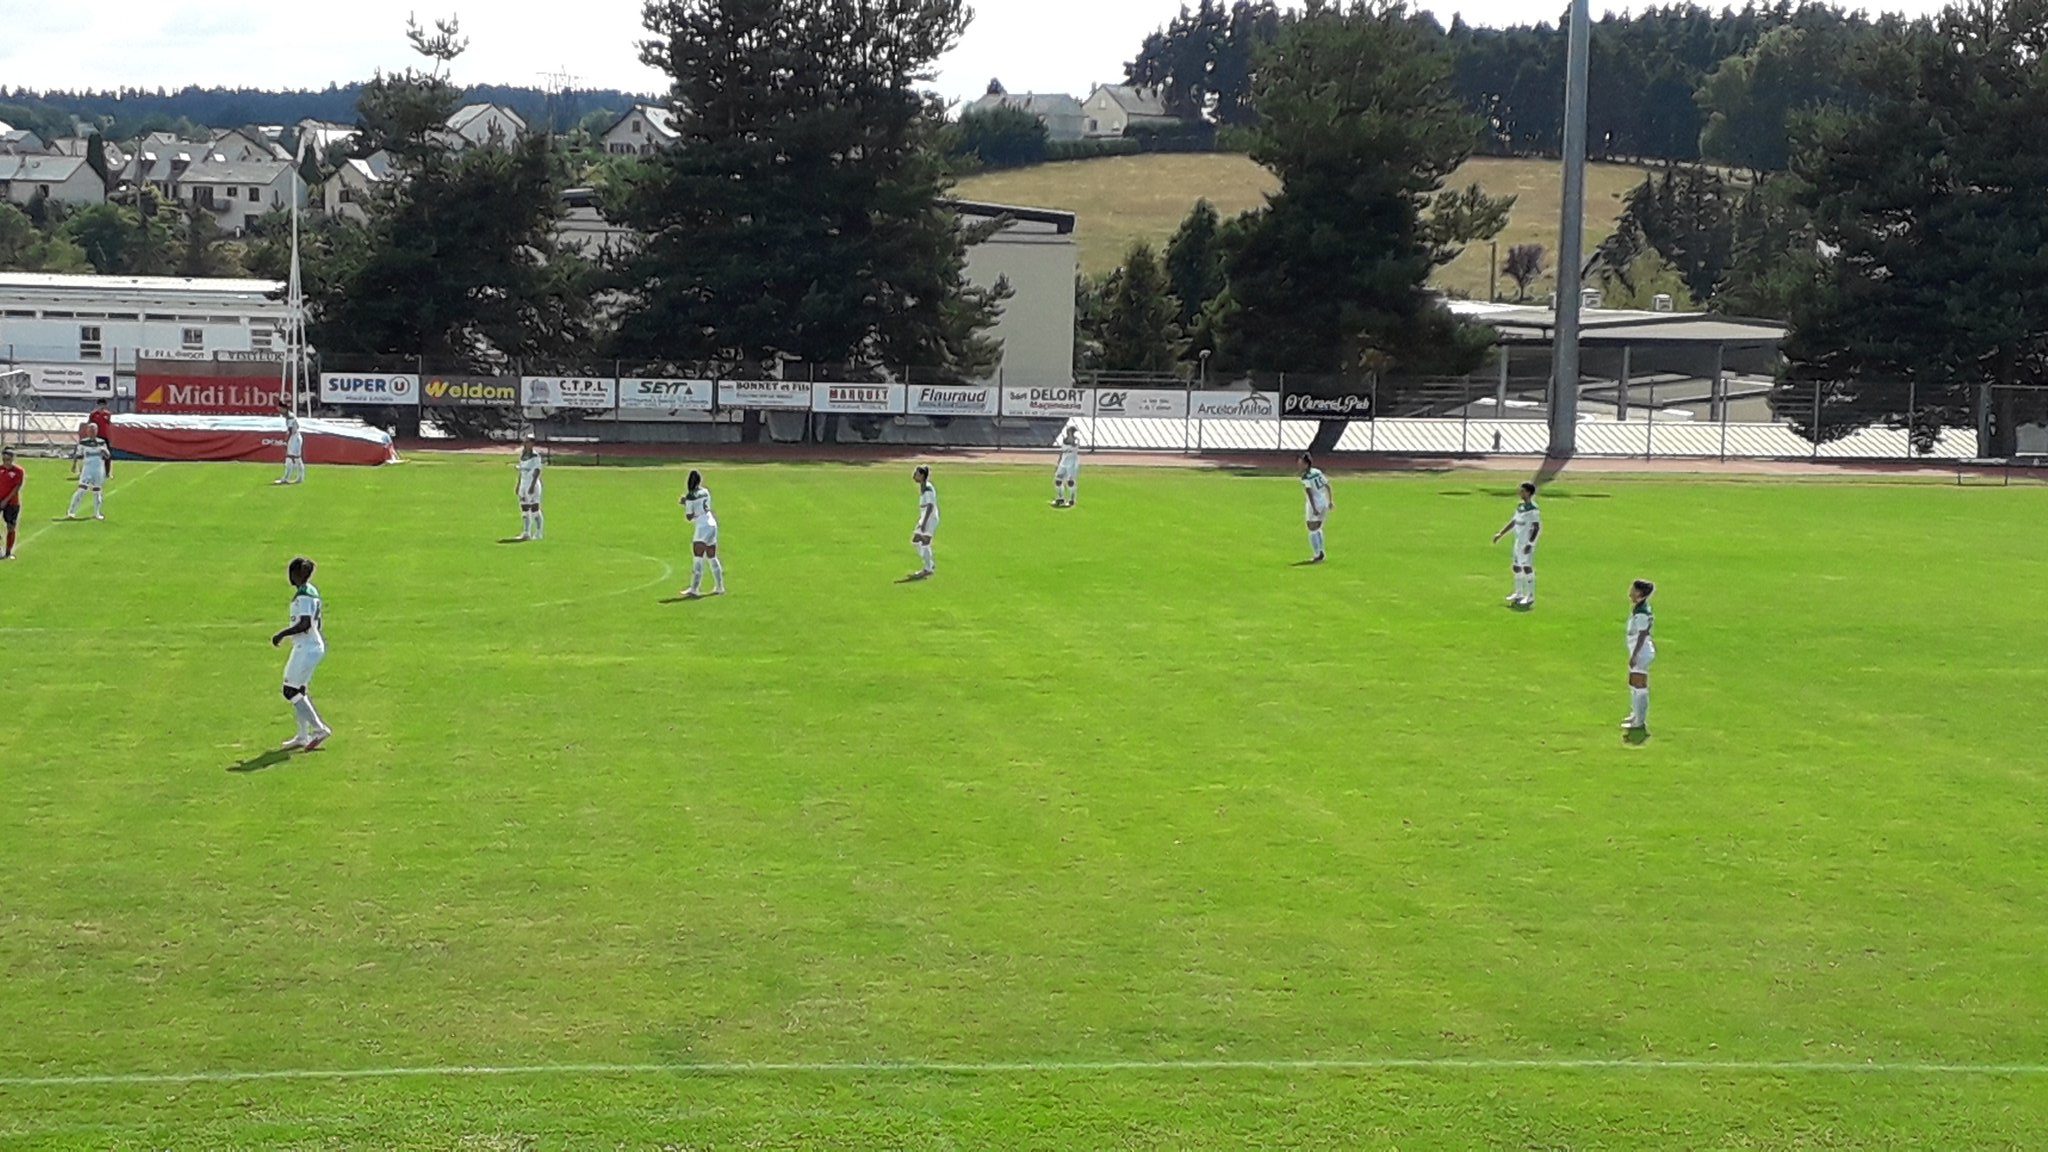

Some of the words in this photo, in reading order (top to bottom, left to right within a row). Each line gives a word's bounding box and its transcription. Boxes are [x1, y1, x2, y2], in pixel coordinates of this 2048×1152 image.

[328, 377, 386, 392] SUPER
[393, 380, 406, 391] U
[425, 380, 515, 398] Weldom
[736, 381, 778, 391] BONNET
[167, 384, 224, 406] Midi
[229, 385, 292, 406] Libre
[829, 388, 888, 400] MARQUET
[920, 388, 987, 402] Flauraud
[1030, 388, 1086, 402] DELORT
